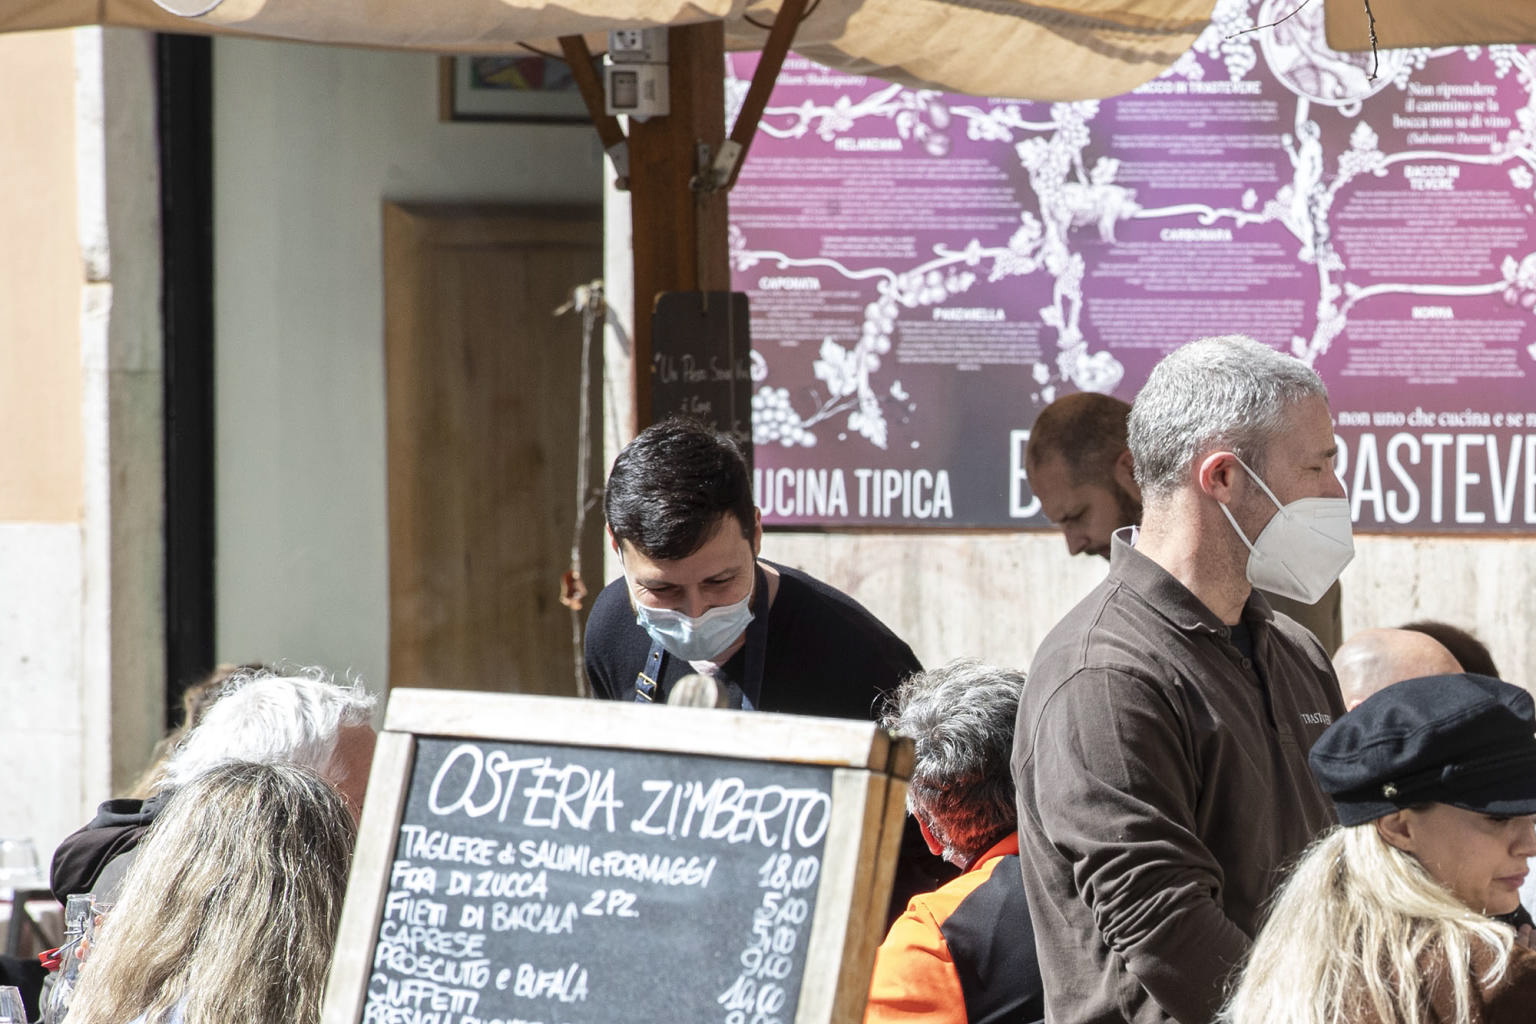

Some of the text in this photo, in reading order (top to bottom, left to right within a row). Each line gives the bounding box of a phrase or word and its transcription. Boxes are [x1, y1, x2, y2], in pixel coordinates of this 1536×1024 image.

[1408, 80, 1497, 99] Non riprendere
[1416, 99, 1472, 112] cammino
[1393, 114, 1428, 128] bocca
[1429, 117, 1453, 128] non
[1484, 116, 1512, 128] vino
[1160, 228, 1233, 242] CARBONARA
[759, 276, 821, 290] CAPONATA
[1338, 410, 1371, 427] non
[1373, 411, 1406, 427] uno
[1407, 407, 1437, 427] che
[1438, 408, 1491, 427] cucina
[1493, 413, 1503, 427] e
[1505, 413, 1524, 427] se
[753, 467, 848, 517] UCINA
[854, 468, 953, 519] TIPICA
[428, 744, 624, 832] OSTERIA
[401, 824, 499, 866] TAGLIERE
[519, 839, 590, 877] SALUMI
[602, 850, 717, 888] FORMAGGI
[446, 870, 472, 897] DI
[473, 870, 549, 901] ZUCCA
[459, 904, 484, 931] DI
[379, 919, 488, 959] CAPRESE
[496, 967, 512, 991] e
[513, 961, 589, 1003] BUFALA
